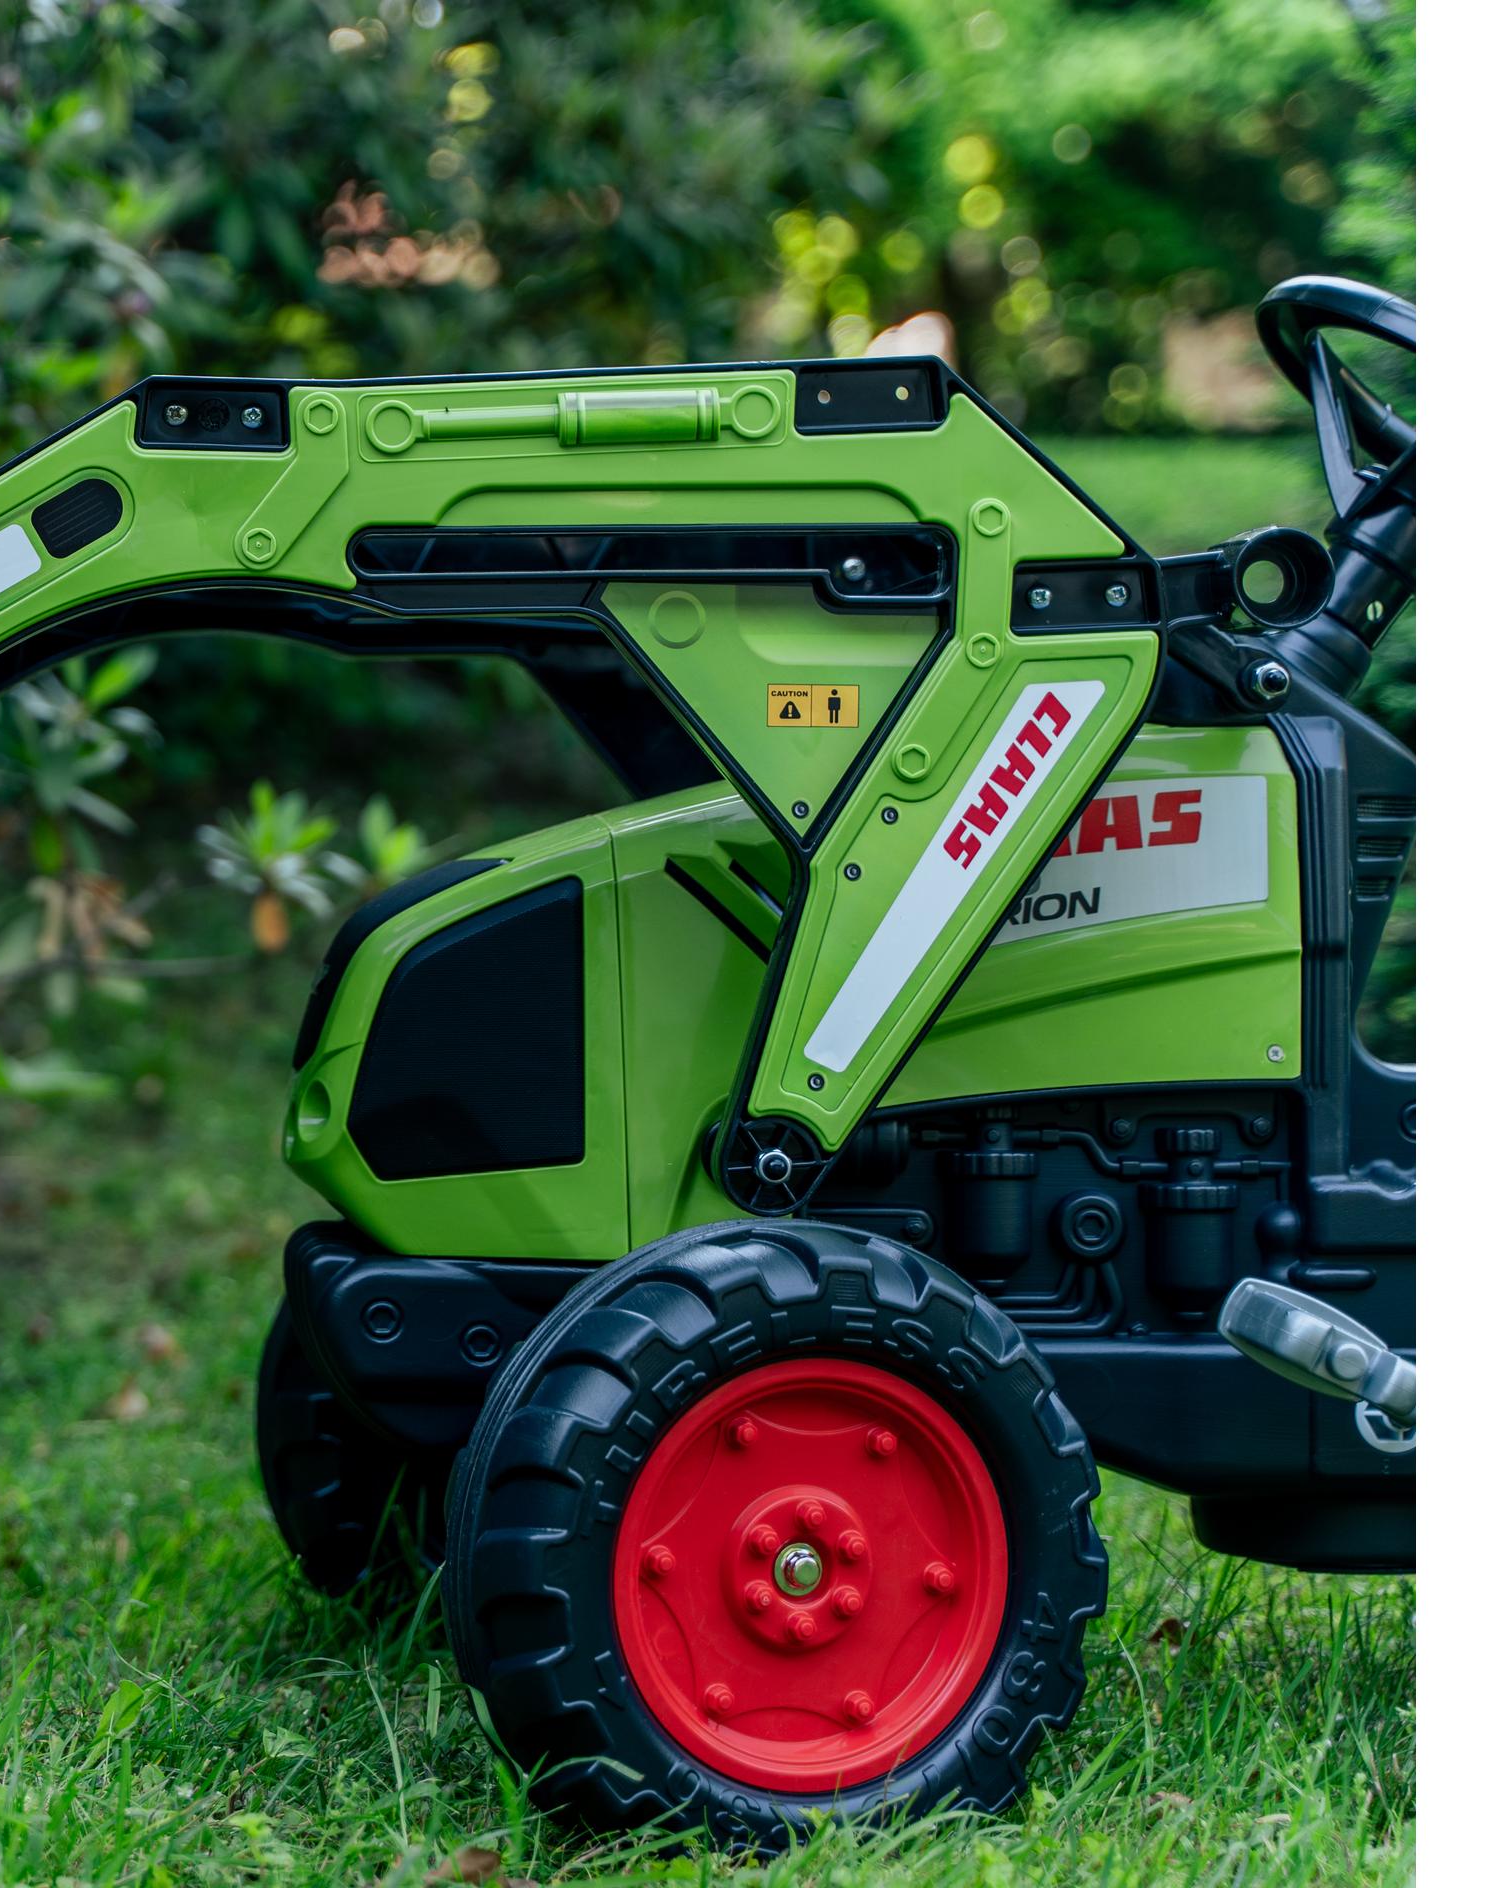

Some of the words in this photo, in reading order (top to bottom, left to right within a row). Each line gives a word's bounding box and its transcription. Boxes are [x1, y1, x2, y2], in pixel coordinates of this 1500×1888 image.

[943, 691, 1072, 870] CLAAS
[1051, 789, 1202, 858] AS
[582, 1303, 986, 1538] TUBELESS
